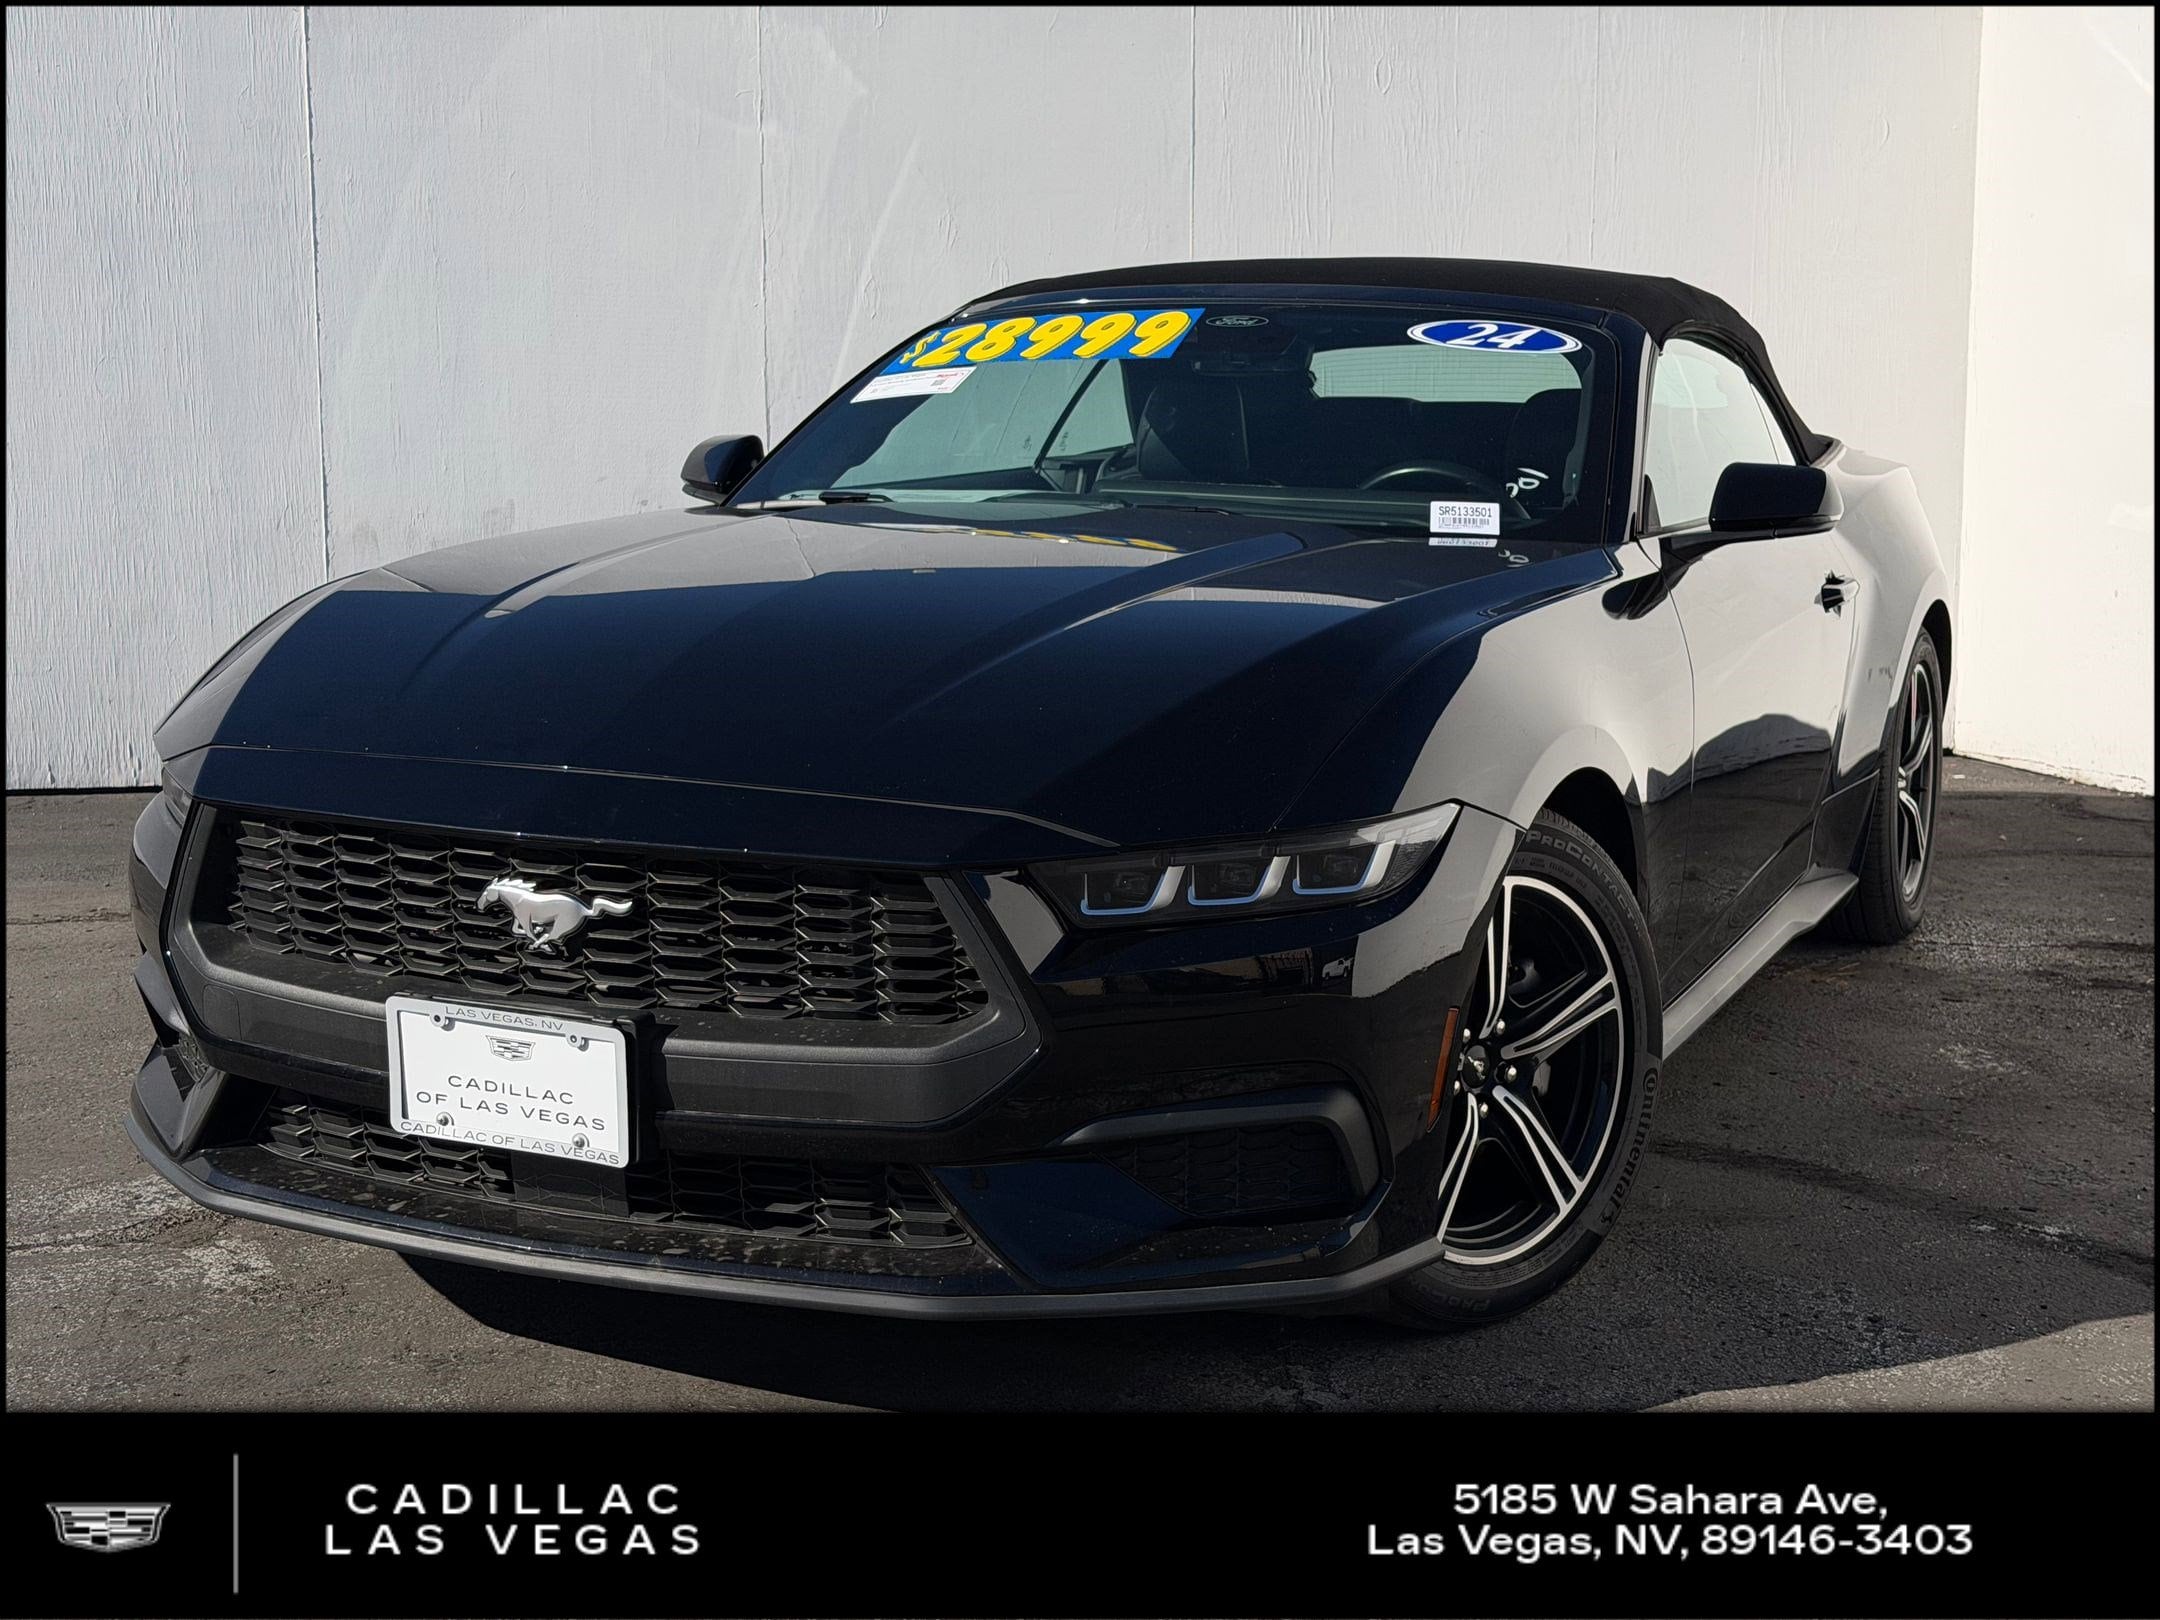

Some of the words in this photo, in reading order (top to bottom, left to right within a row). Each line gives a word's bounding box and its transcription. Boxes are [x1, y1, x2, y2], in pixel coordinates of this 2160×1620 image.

[899, 310, 1193, 368] $28999
[1445, 322, 1538, 350] 24
[1438, 505, 1493, 519] SR5133501
[445, 1006, 477, 1018] LAS
[541, 1020, 564, 1031] NV
[447, 1075, 574, 1105] CADILLAC
[416, 1091, 448, 1105] OF
[460, 1097, 509, 1115] LAS
[520, 1105, 605, 1131] VEGAS
[400, 1121, 487, 1143] CADILLAC
[491, 1133, 515, 1146] OF
[520, 1137, 556, 1153] LAS
[560, 1144, 620, 1165] VEGAS
